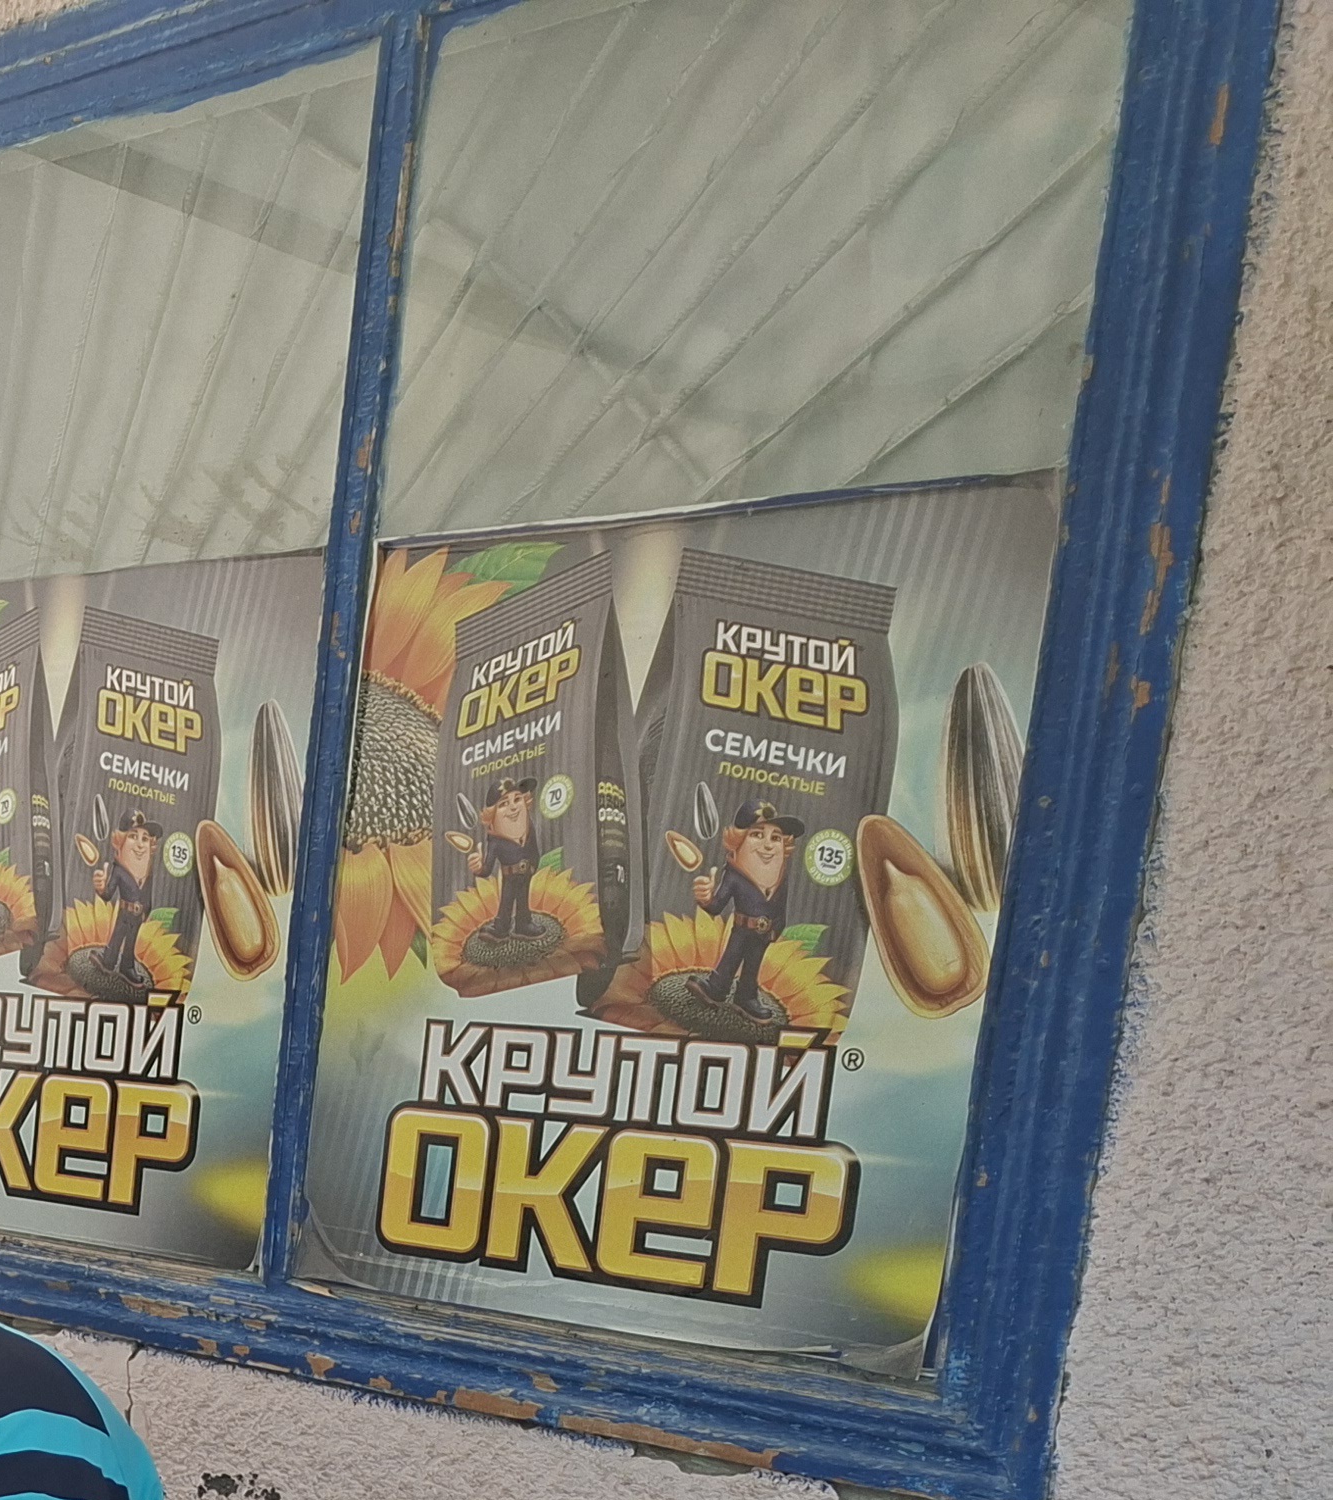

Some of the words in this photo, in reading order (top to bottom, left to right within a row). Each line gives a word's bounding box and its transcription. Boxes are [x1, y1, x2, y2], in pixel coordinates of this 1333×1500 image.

[470, 620, 576, 691] КРУТОЙ
[716, 620, 855, 676] КРУТОЙ
[105, 664, 195, 710] КРУТОЙ
[461, 710, 562, 767] СЕМЕЧКИ
[704, 728, 847, 779] СЕМЕЧКИ
[99, 751, 190, 792] СЕМЕЧКИ
[470, 742, 547, 779] ПОЛОСАТЫЕ
[718, 761, 827, 796] ПОЛОСАТЫЕ
[108, 777, 177, 806] ПОЛОСАТЫЕ
[549, 788, 562, 802] 70
[171, 844, 188, 861] 135
[818, 845, 845, 866] 135
[420, 1018, 839, 1139] КРУТОЙ
